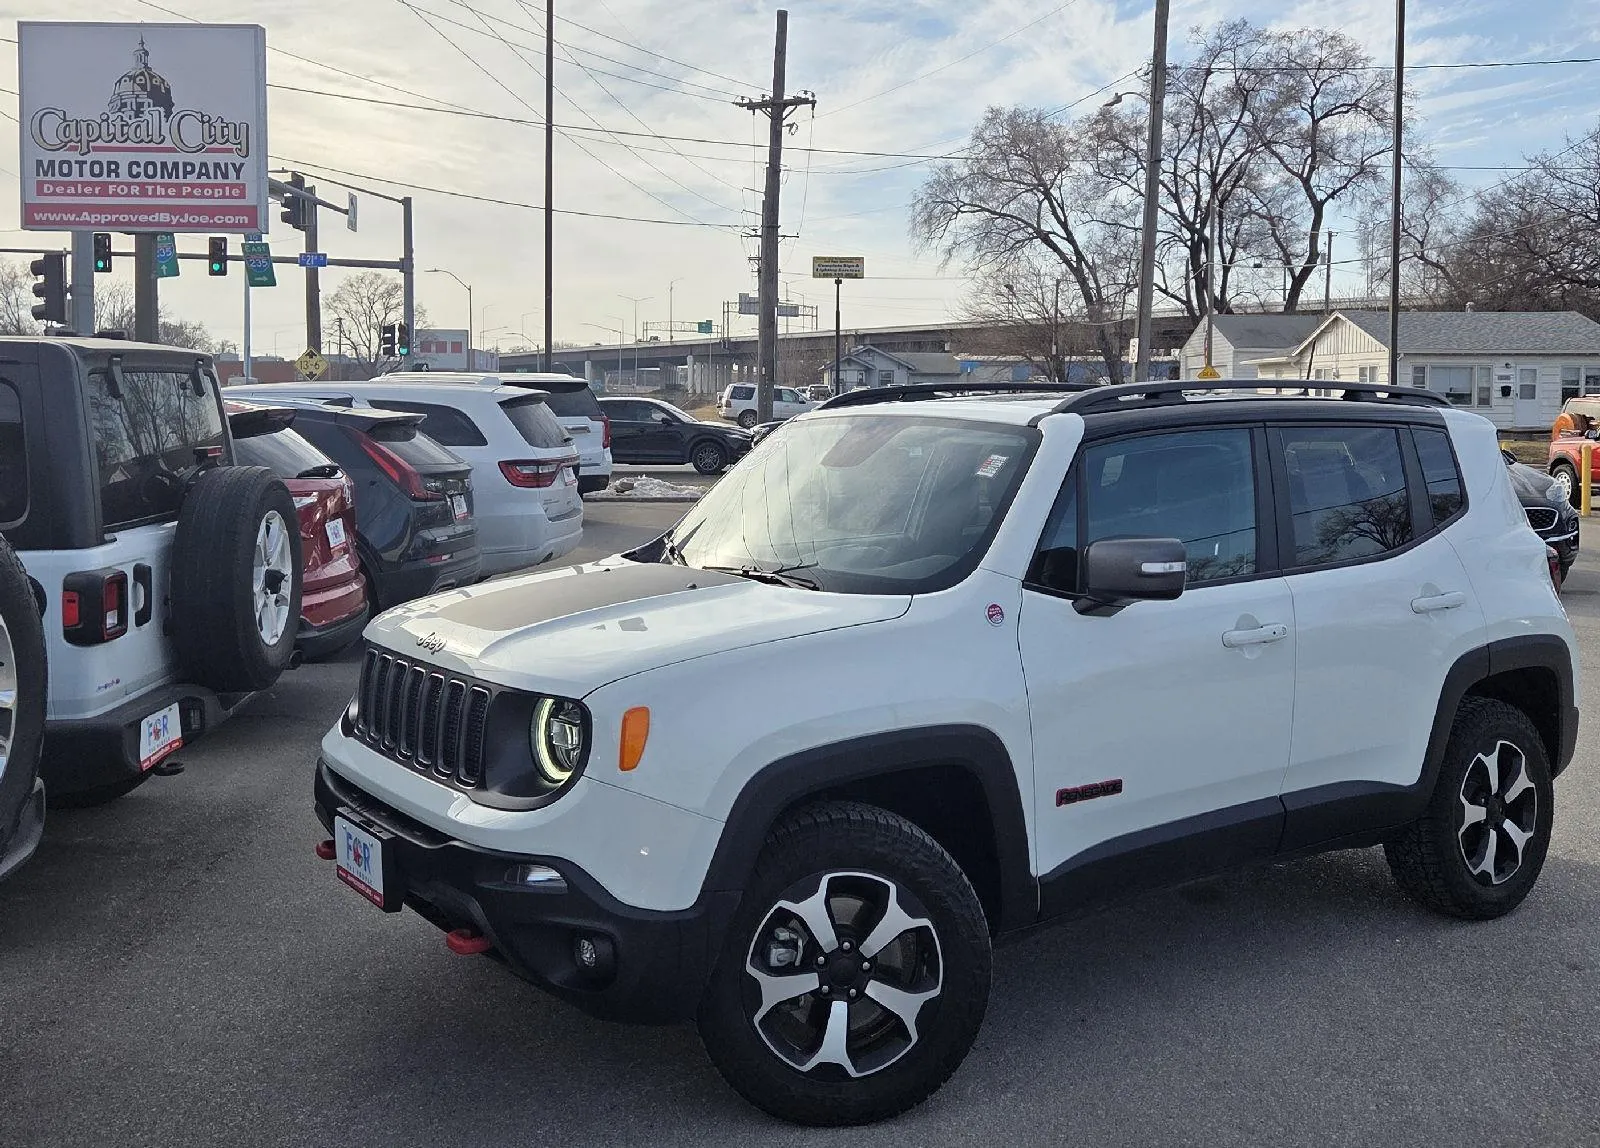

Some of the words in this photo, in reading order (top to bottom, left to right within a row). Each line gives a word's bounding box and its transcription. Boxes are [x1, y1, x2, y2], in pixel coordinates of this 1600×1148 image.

[30, 106, 166, 156] Capital
[169, 109, 249, 158] City
[35, 159, 120, 179] MOTOR
[127, 160, 245, 181] COMPANY
[43, 183, 101, 194] Dealer
[108, 184, 140, 196] FOR
[145, 185, 177, 196] The
[182, 186, 241, 198] People
[33, 211, 249, 225] www.ApprovedByJoe.com
[245, 244, 266, 252] EAST
[249, 259, 268, 268] 235
[416, 631, 447, 655] Jeep
[1056, 779, 1122, 807] RENEGADE
